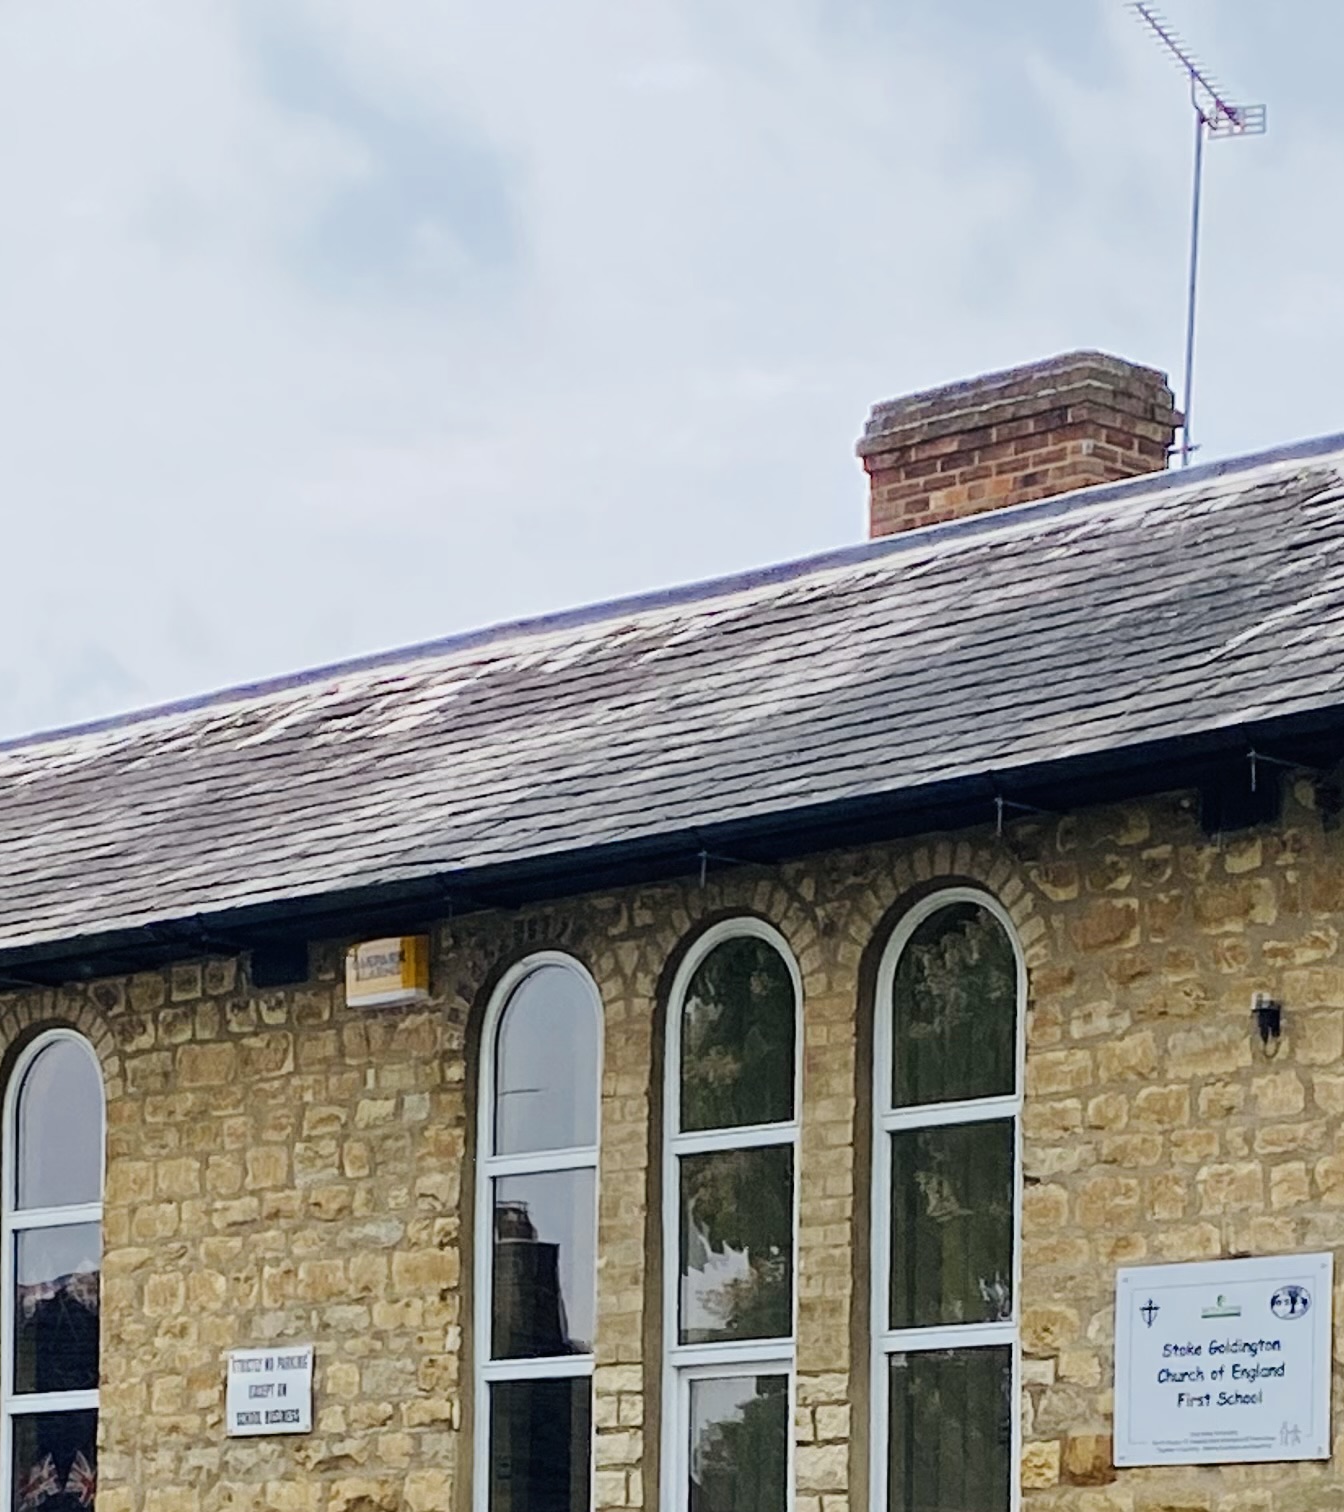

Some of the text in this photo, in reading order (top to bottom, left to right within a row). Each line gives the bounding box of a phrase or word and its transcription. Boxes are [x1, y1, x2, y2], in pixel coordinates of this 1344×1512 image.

[1162, 1337, 1281, 1358] Stoke Goldington
[1157, 1361, 1285, 1383] Church of England
[1177, 1388, 1263, 1408] First School
